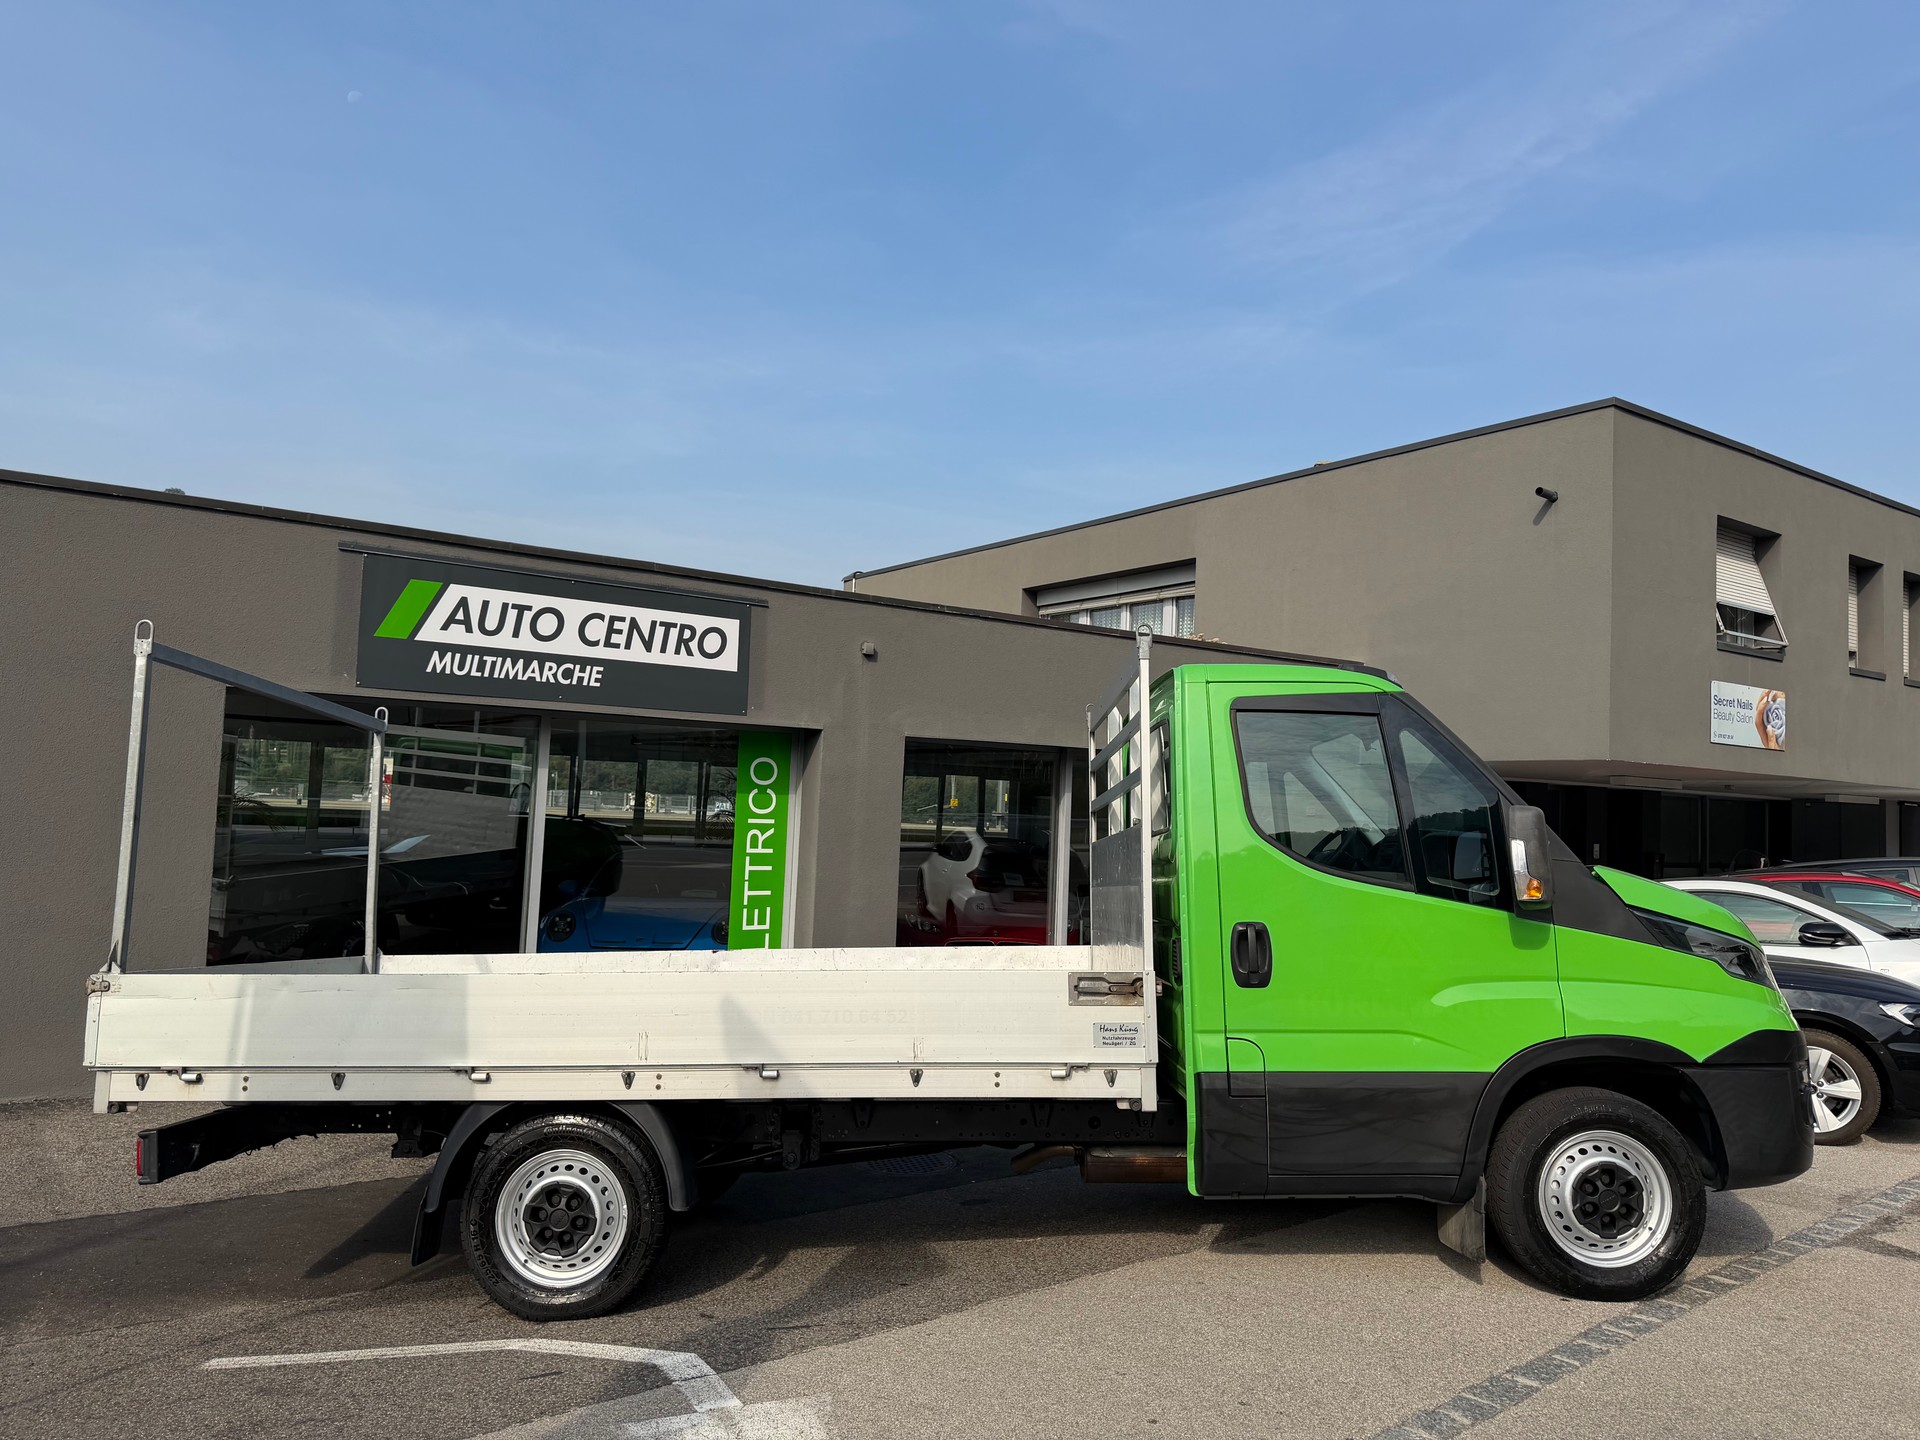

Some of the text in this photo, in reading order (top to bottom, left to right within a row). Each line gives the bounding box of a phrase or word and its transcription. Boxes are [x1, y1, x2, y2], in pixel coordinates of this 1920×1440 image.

[440, 596, 728, 660] AUTO CENTRO
[425, 650, 604, 688] MULTIMARCHE
[1713, 694, 1754, 711] Secret Nails
[1713, 708, 1754, 724] Beauty Salon
